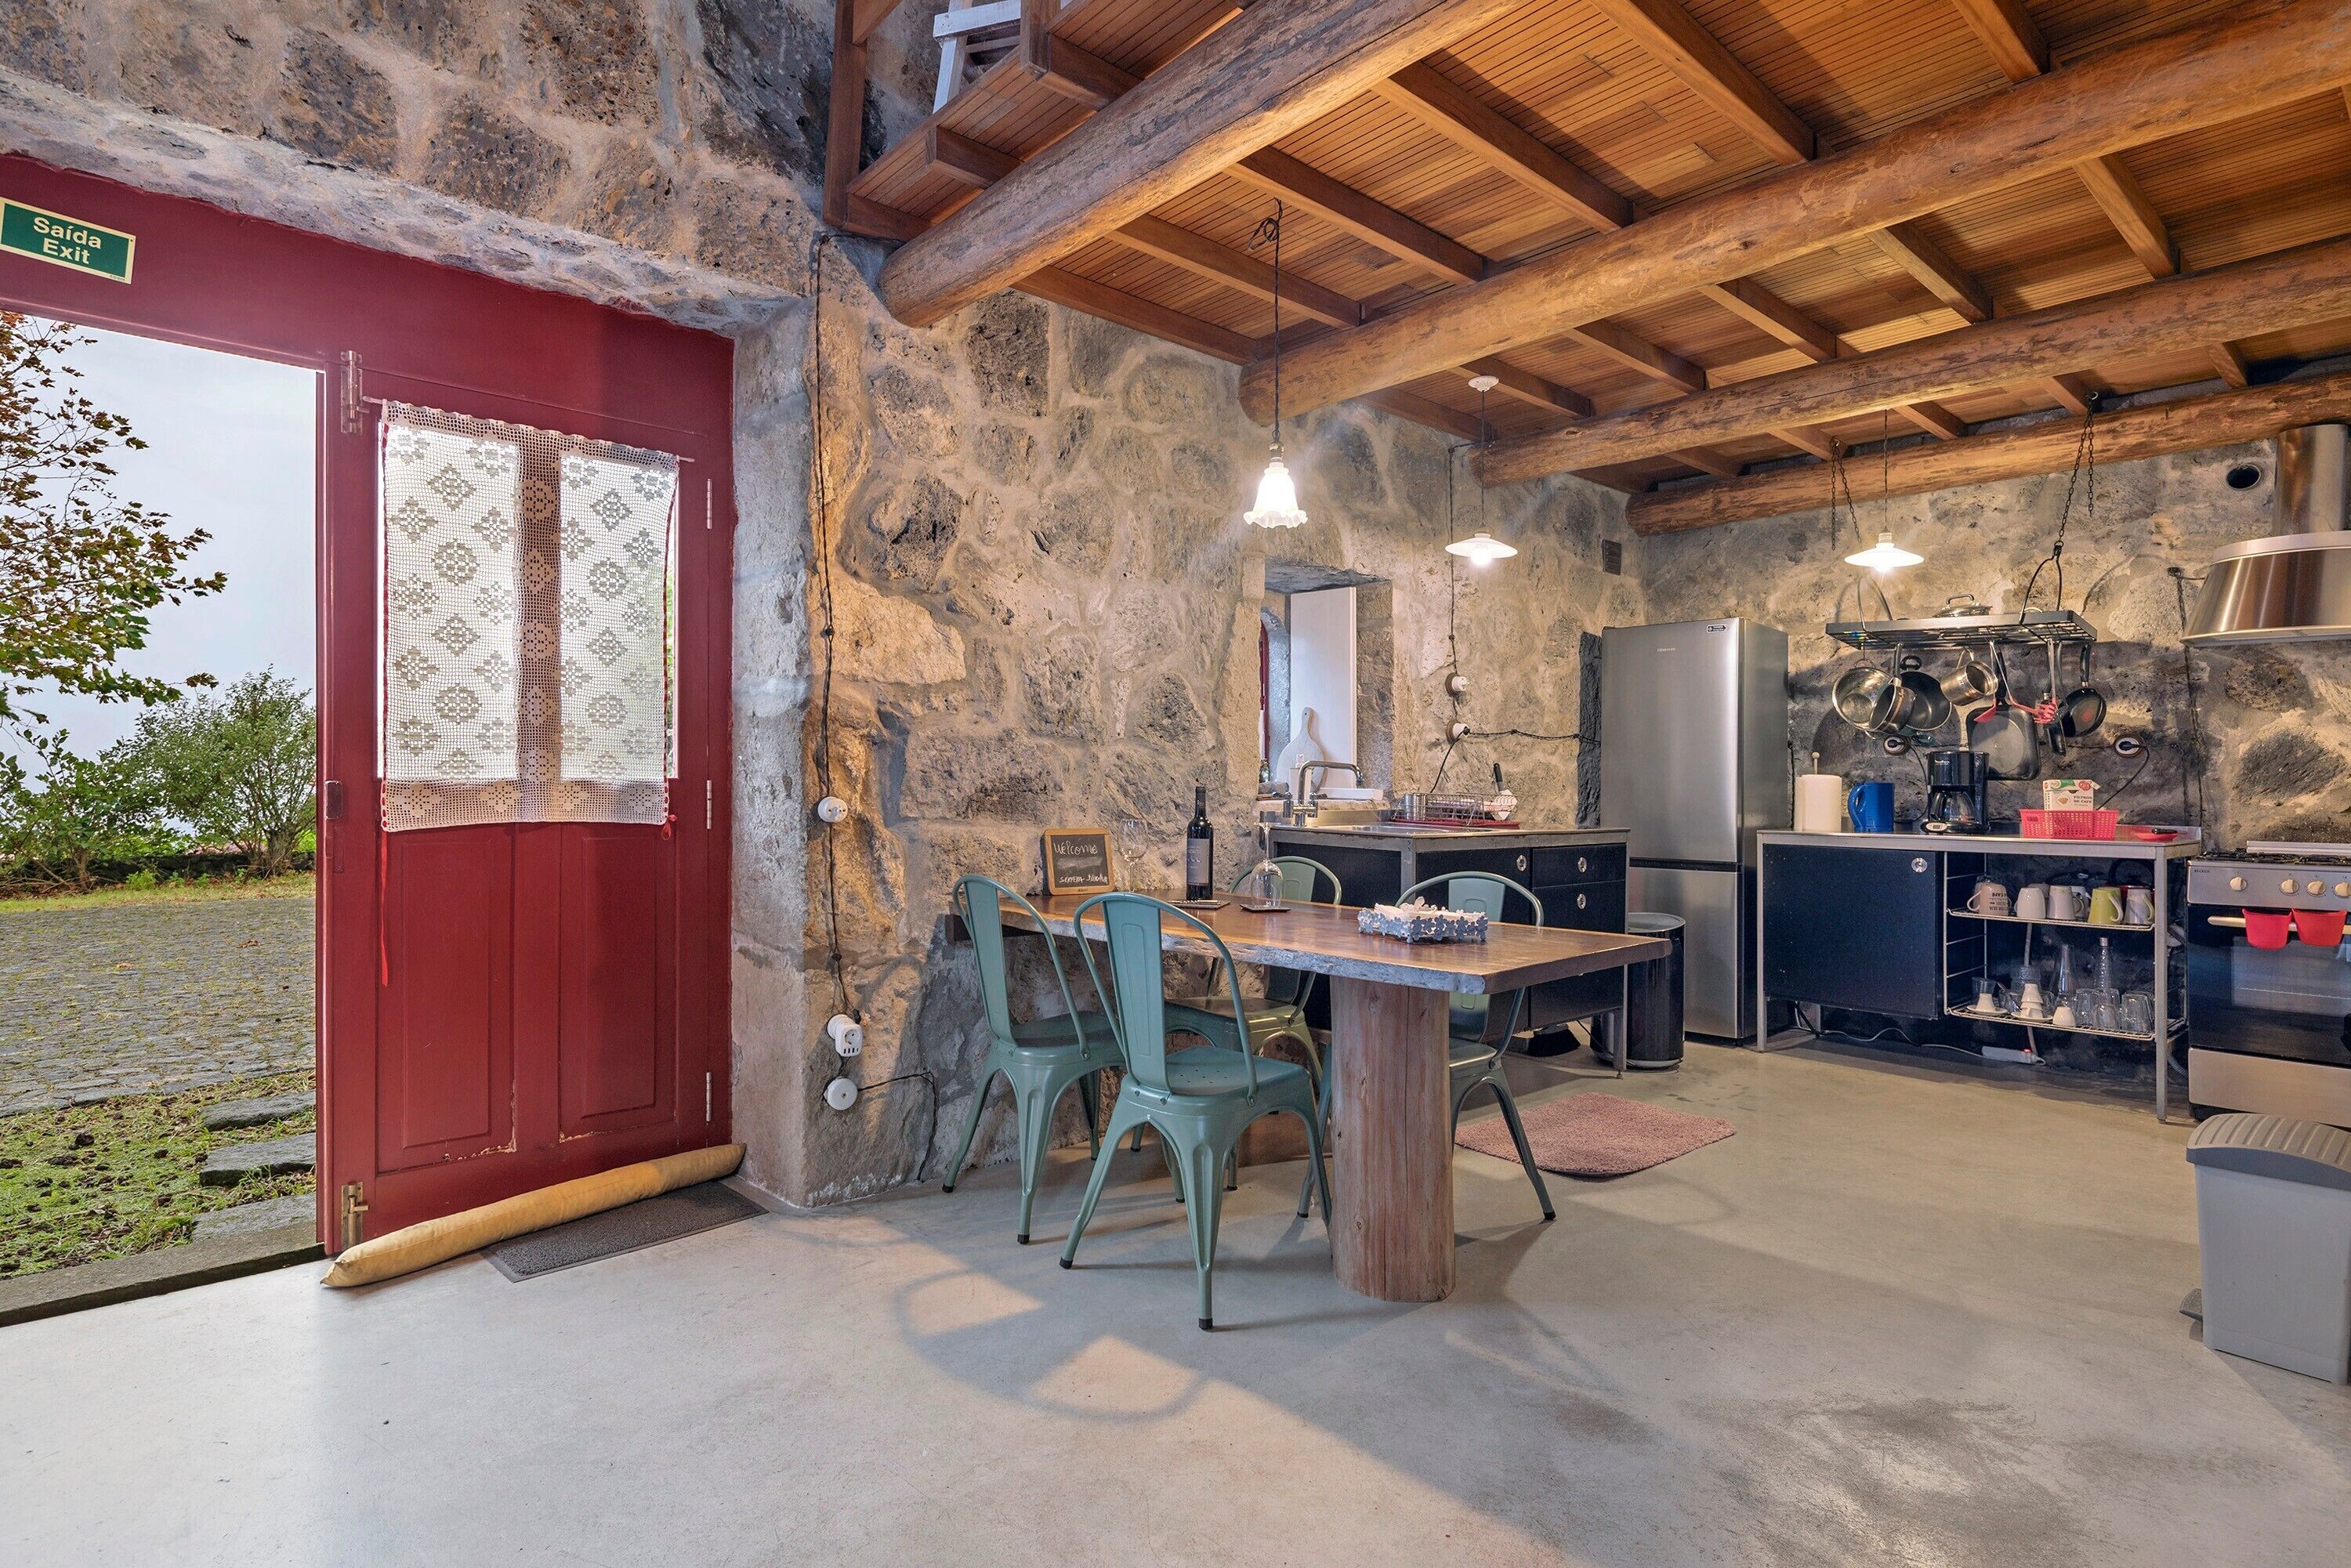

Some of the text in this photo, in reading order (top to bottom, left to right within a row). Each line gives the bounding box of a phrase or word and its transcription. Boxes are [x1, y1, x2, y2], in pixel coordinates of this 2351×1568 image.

[33, 216, 102, 249] Saída
[43, 237, 90, 264] Exit
[1052, 840, 1098, 855] Welcome
